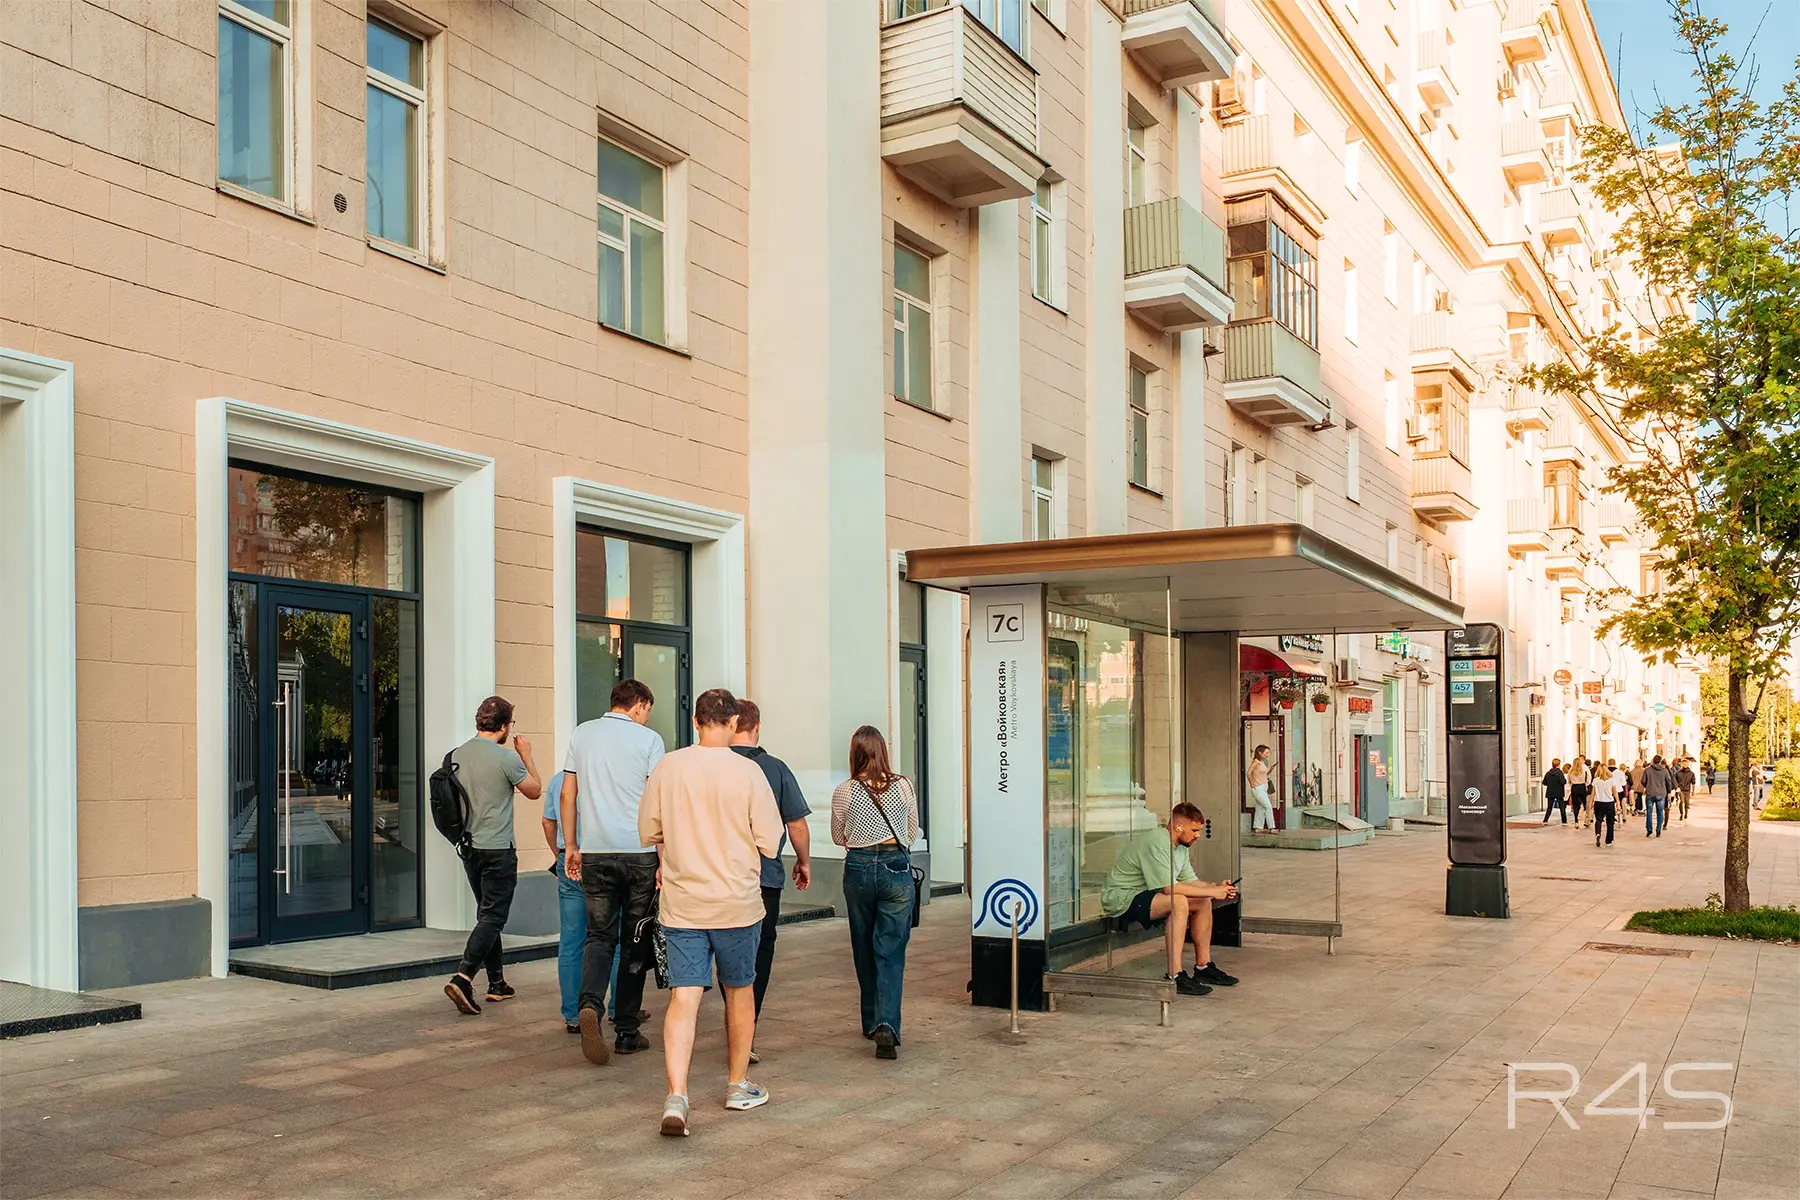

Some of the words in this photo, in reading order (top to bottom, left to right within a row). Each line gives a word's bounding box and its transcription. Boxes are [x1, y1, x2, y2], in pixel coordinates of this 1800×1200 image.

[1009, 660, 1018, 712] Voykovskaya
[1454, 662, 1470, 670] 621
[1476, 661, 1493, 669] 243
[997, 660, 1007, 747] «Войковская»
[1010, 713, 1018, 739] Metro
[998, 751, 1009, 793] Метро
